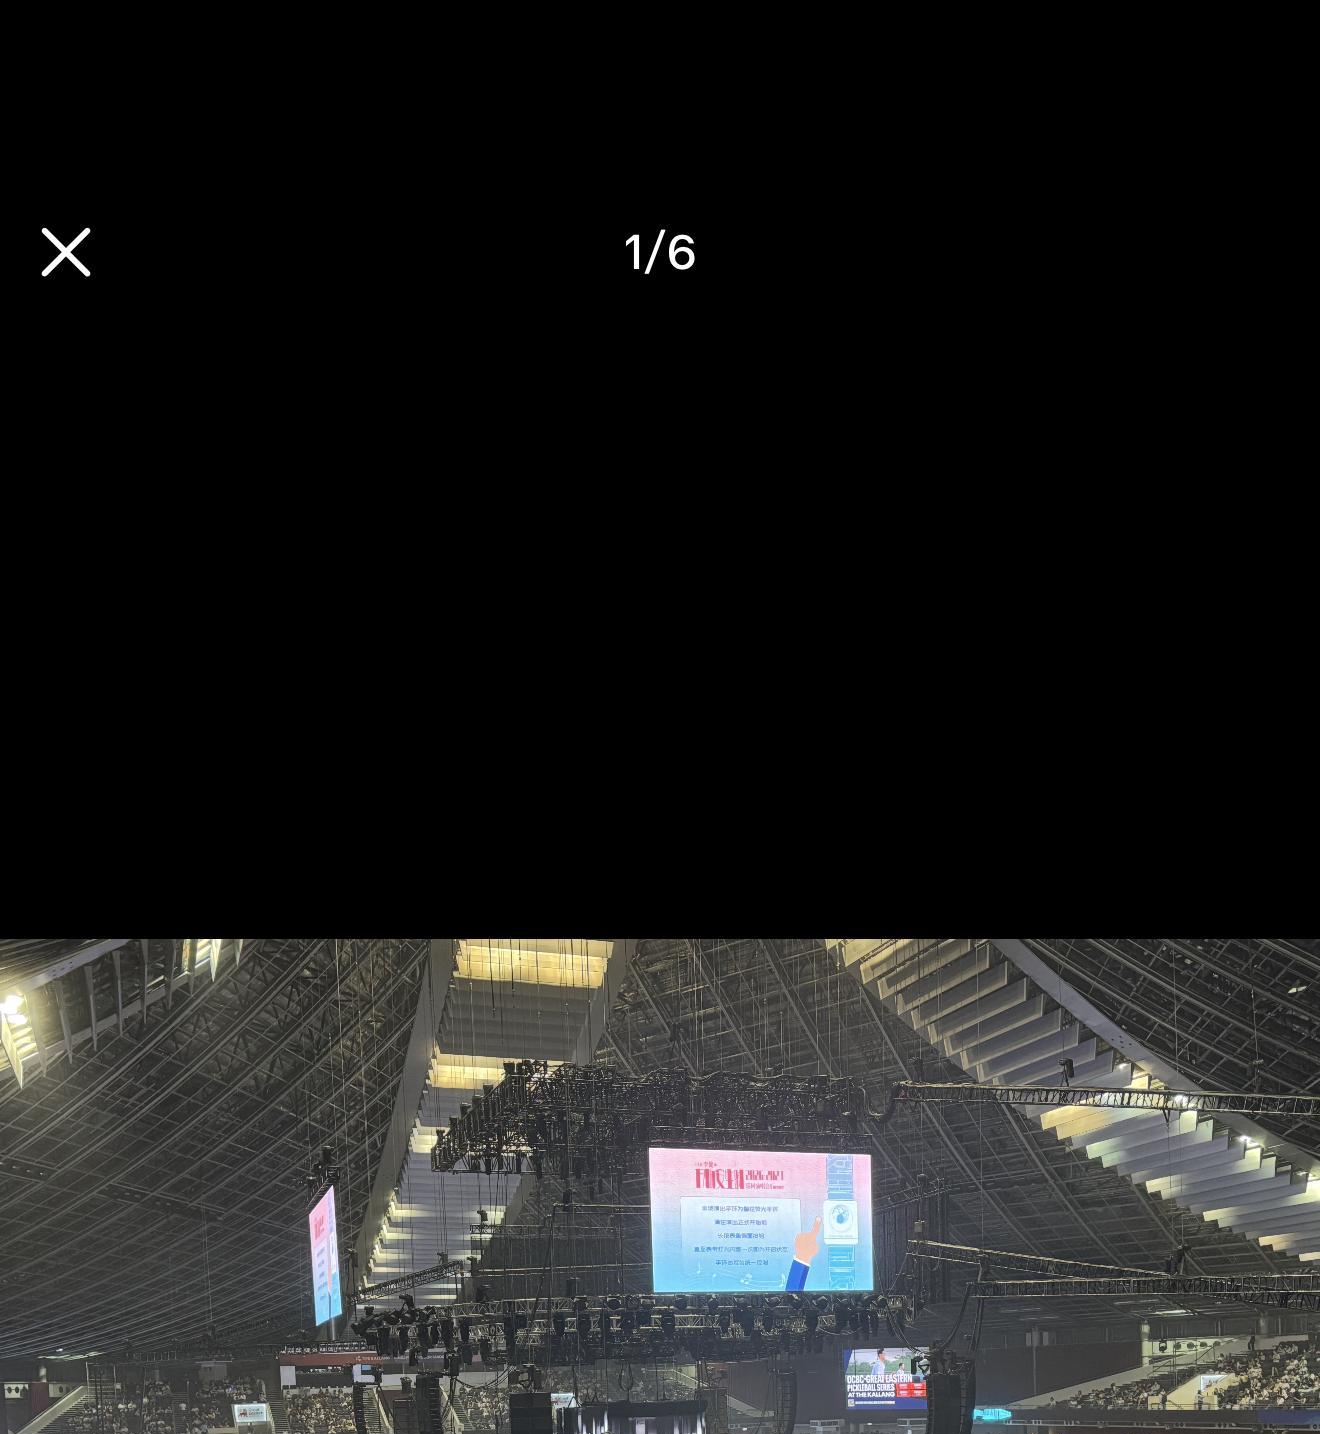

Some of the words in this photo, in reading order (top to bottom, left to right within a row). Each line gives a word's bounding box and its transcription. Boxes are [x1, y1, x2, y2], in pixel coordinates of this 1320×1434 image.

[886, 1374, 913, 1384] EASTERN
[847, 1383, 876, 1392] PICKLEBALL
[877, 1383, 895, 1392] SERIES
